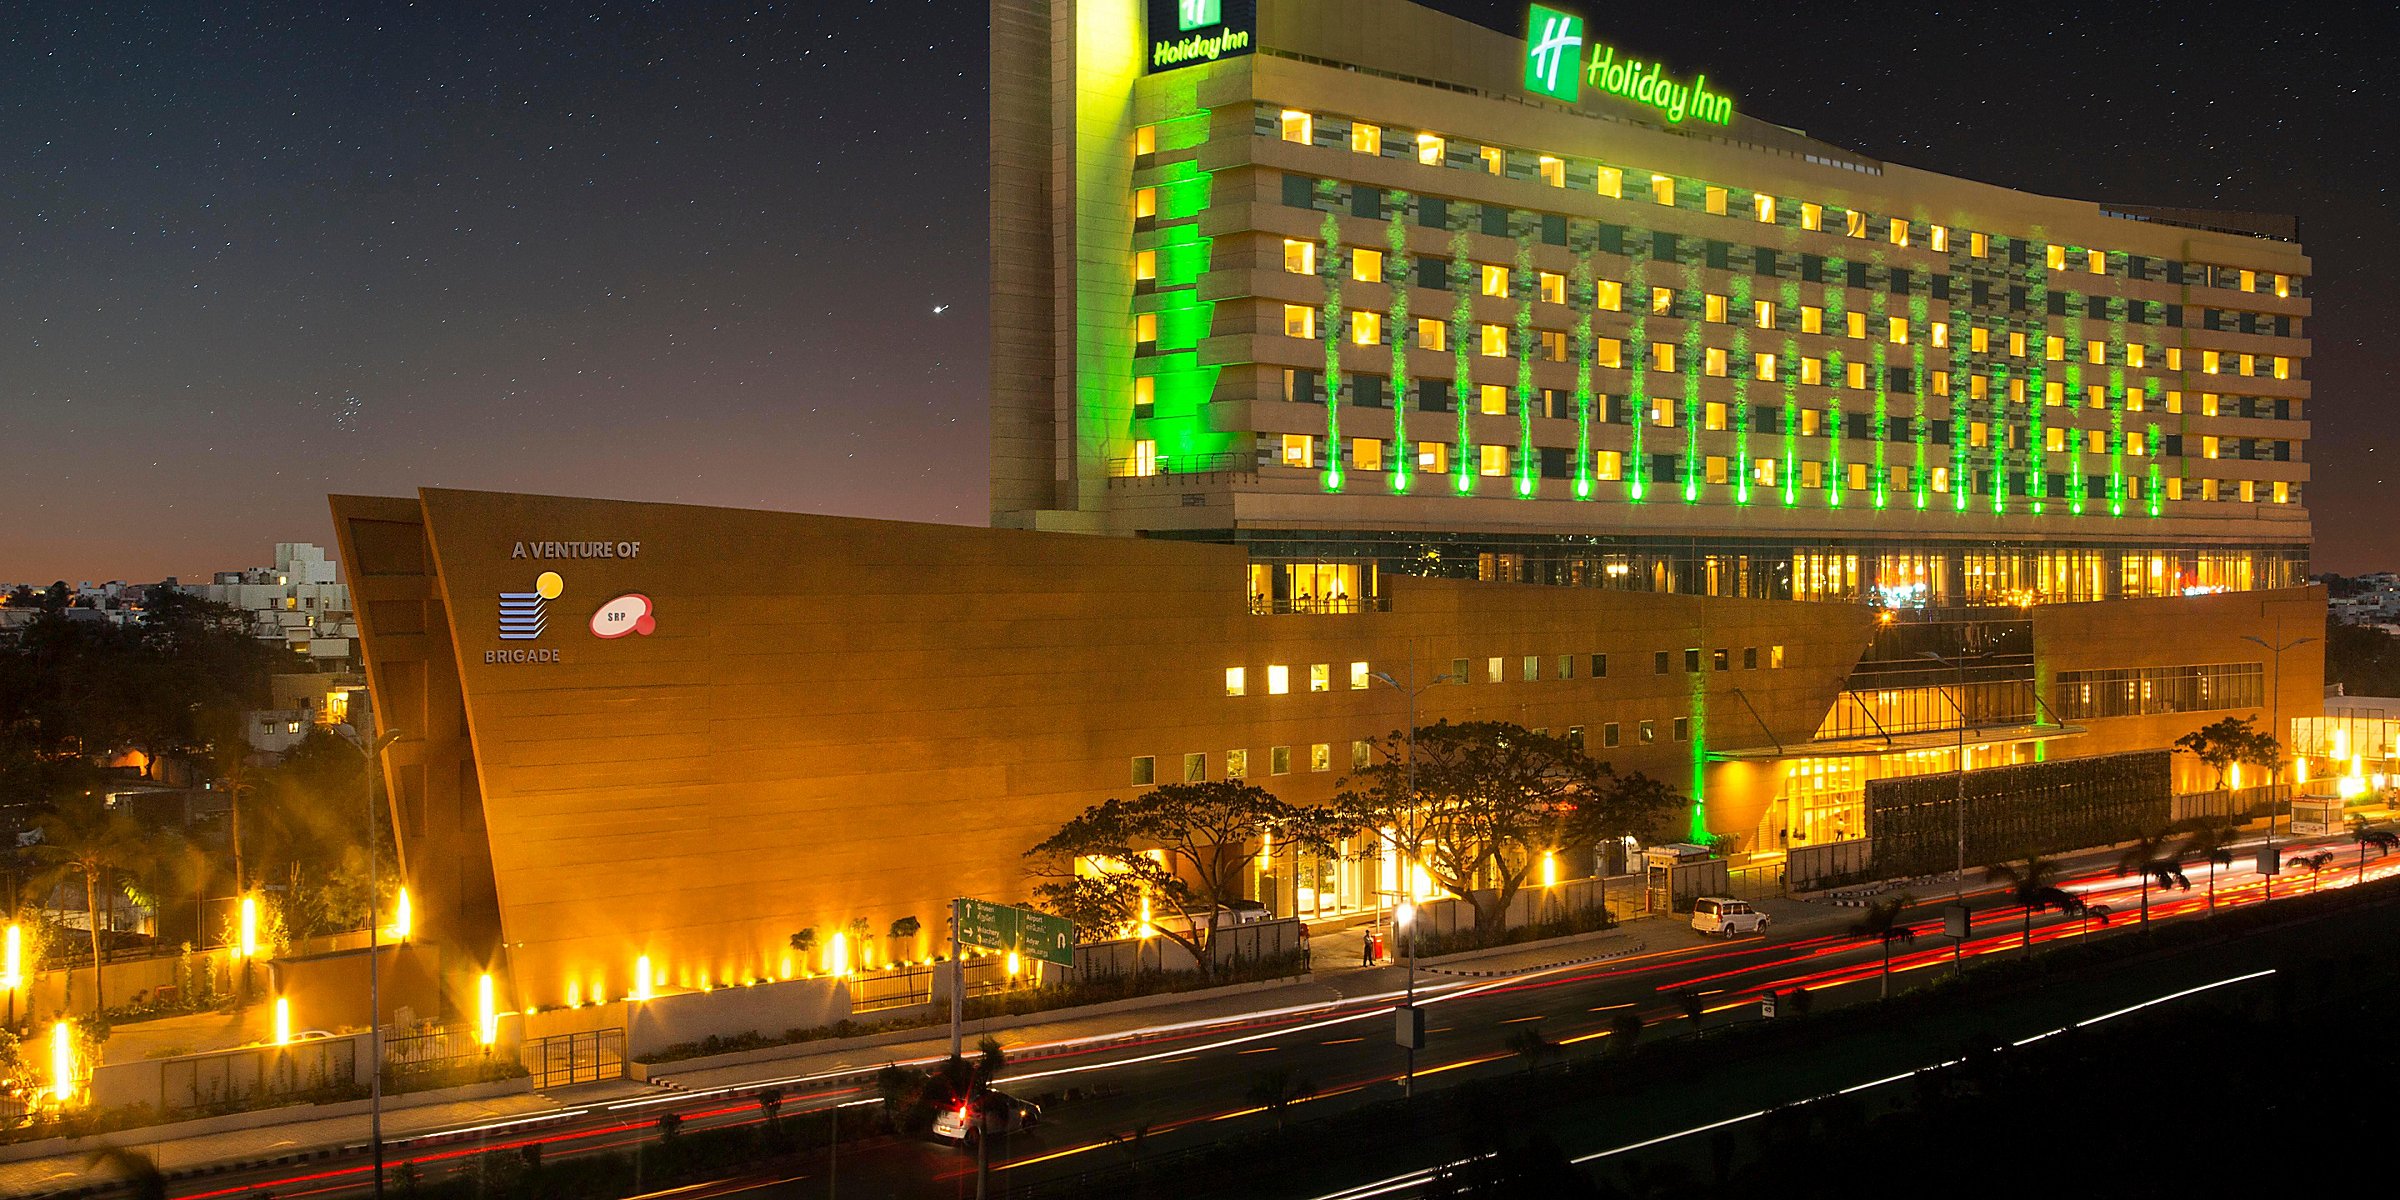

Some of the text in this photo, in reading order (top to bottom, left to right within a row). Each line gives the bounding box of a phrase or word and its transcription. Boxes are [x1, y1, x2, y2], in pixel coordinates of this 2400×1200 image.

[1153, 27, 1249, 66] Holiday Inn
[1587, 43, 1733, 126] Holiday Inn
[511, 541, 641, 559] A VENTURE OF
[607, 612, 627, 622] SRP
[485, 649, 561, 664] BRIGADE
[1026, 914, 1043, 923] Airport
